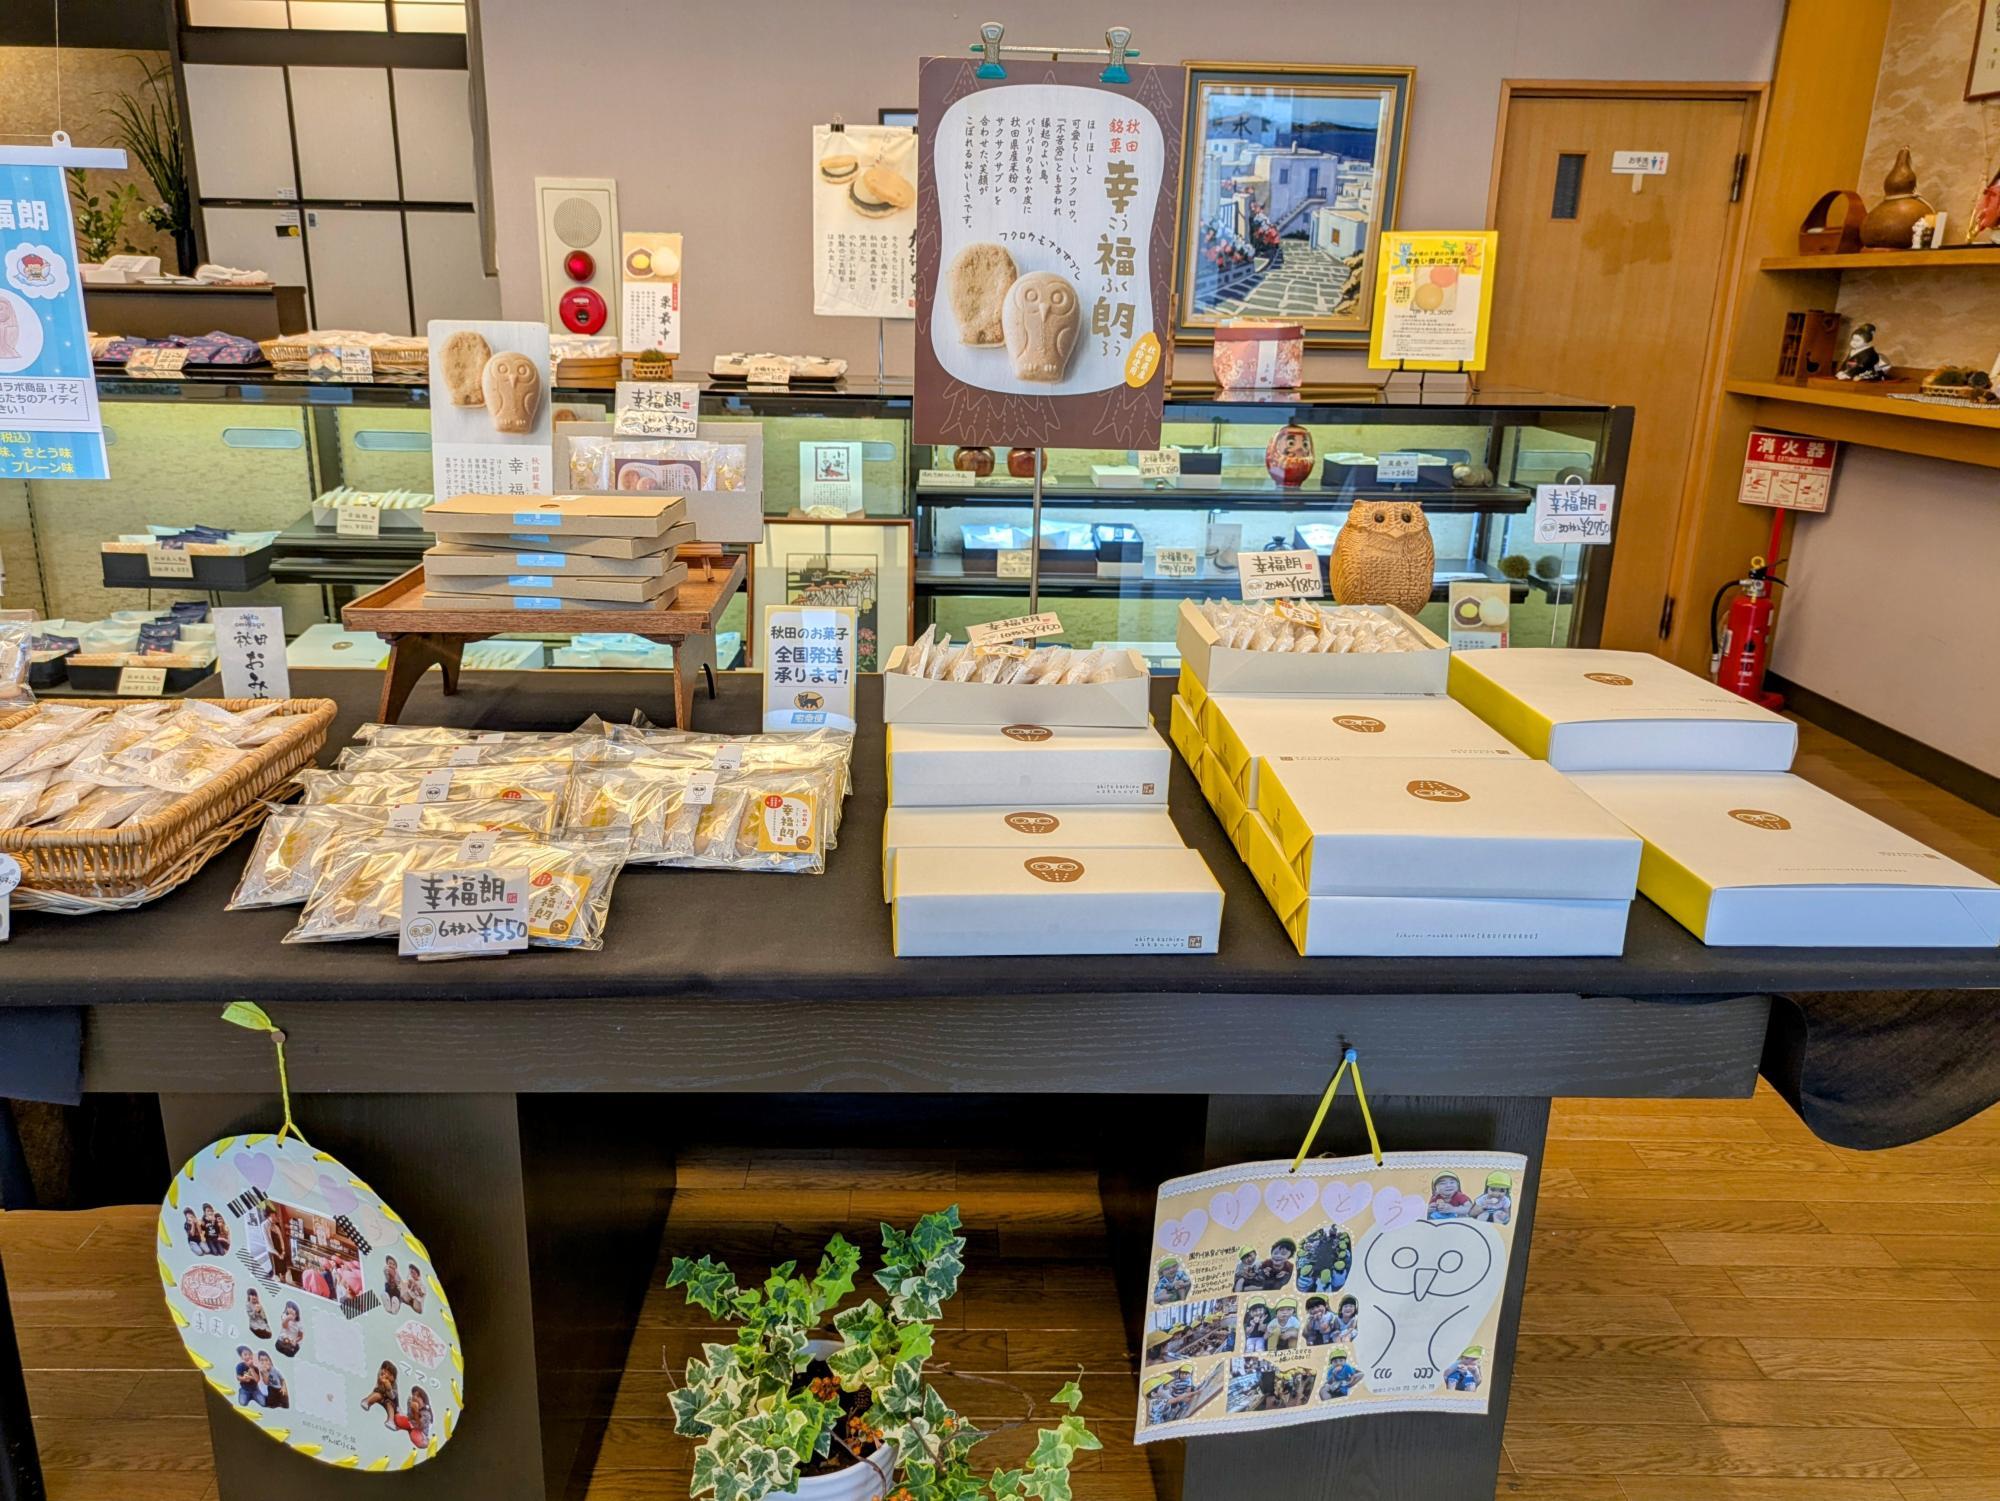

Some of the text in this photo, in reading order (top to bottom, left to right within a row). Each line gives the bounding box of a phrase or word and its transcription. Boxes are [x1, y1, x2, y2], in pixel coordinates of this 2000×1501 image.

[1108, 117, 1124, 154] 銘菓
[1126, 118, 1141, 153] 秋田
[1090, 159, 1140, 340] 幸福朗
[1757, 437, 1826, 458] 消火器
[1548, 489, 1597, 513] 幸福朗
[1251, 555, 1303, 573] 幸福朗
[770, 625, 850, 641] 秋田のお菓子
[774, 645, 844, 665] 全国発送
[779, 803, 795, 838] 幸福朗
[420, 873, 506, 910] 幸福朗
